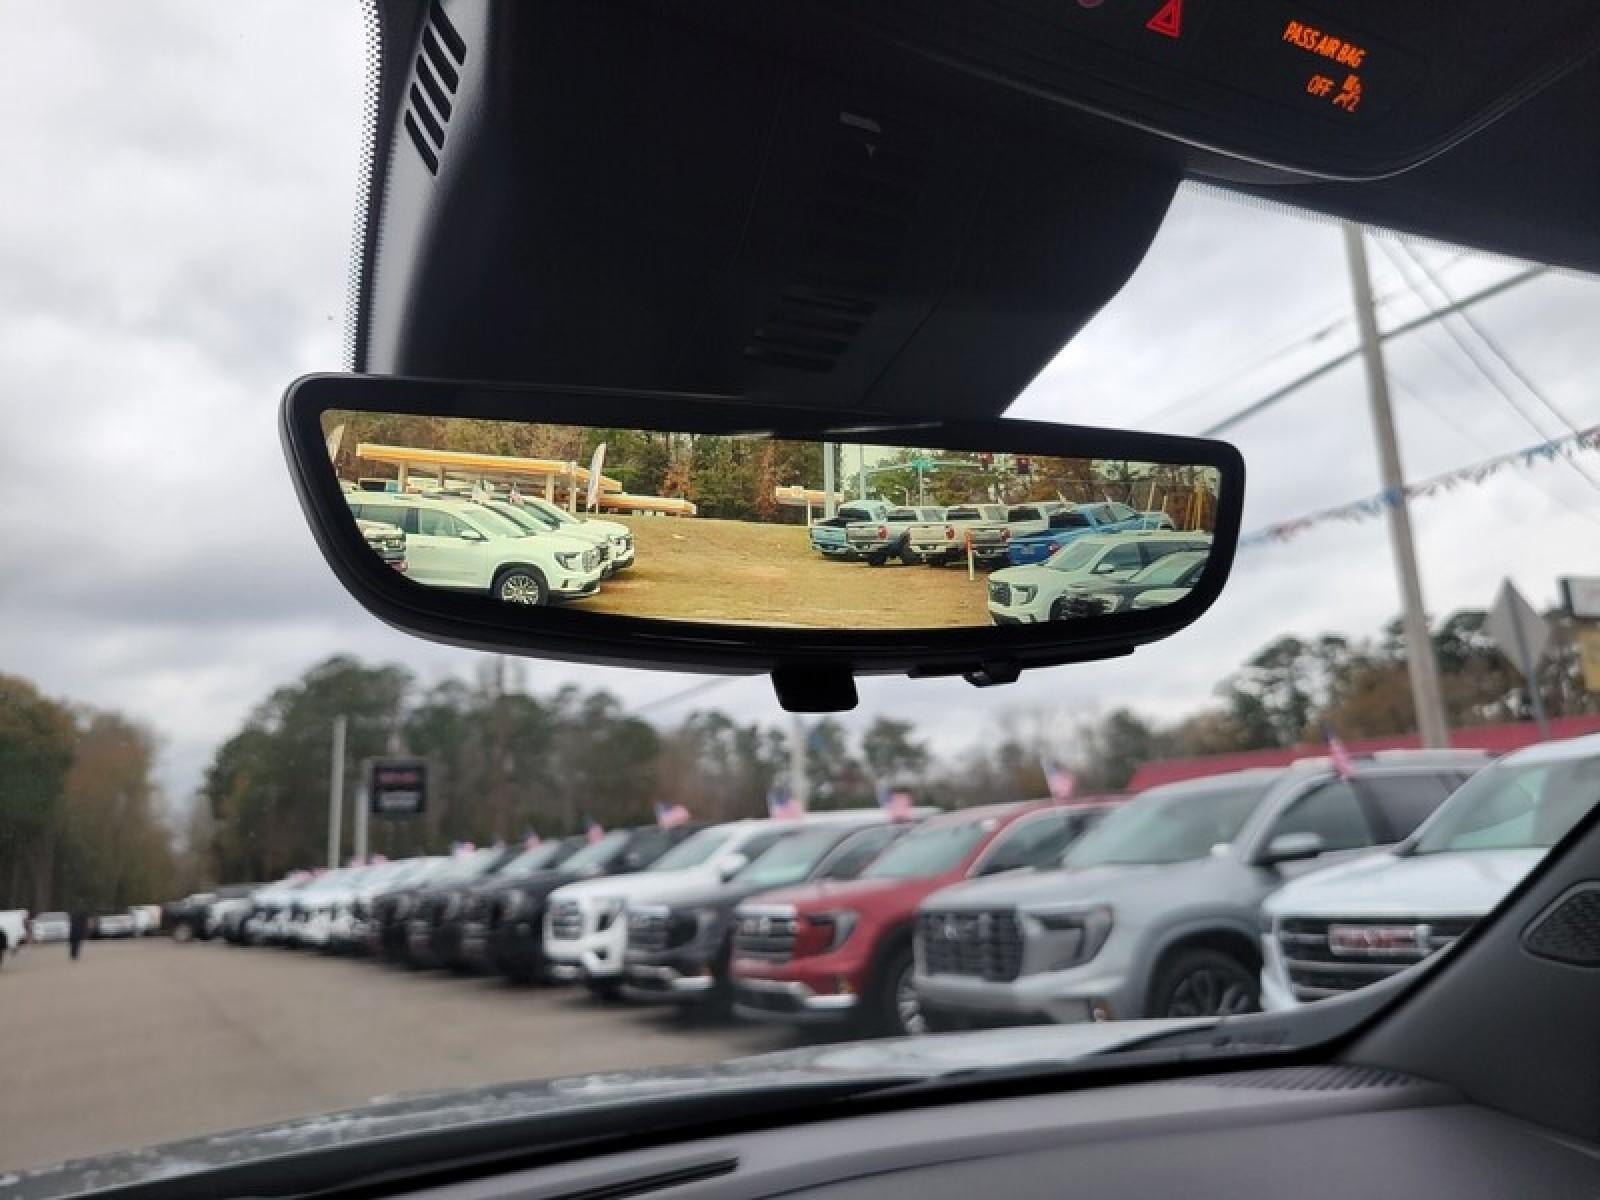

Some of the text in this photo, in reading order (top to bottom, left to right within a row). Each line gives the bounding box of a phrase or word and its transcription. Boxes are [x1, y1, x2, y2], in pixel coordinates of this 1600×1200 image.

[1282, 21, 1366, 68] PASS AIR BAG
[1306, 75, 1335, 96] OFF
